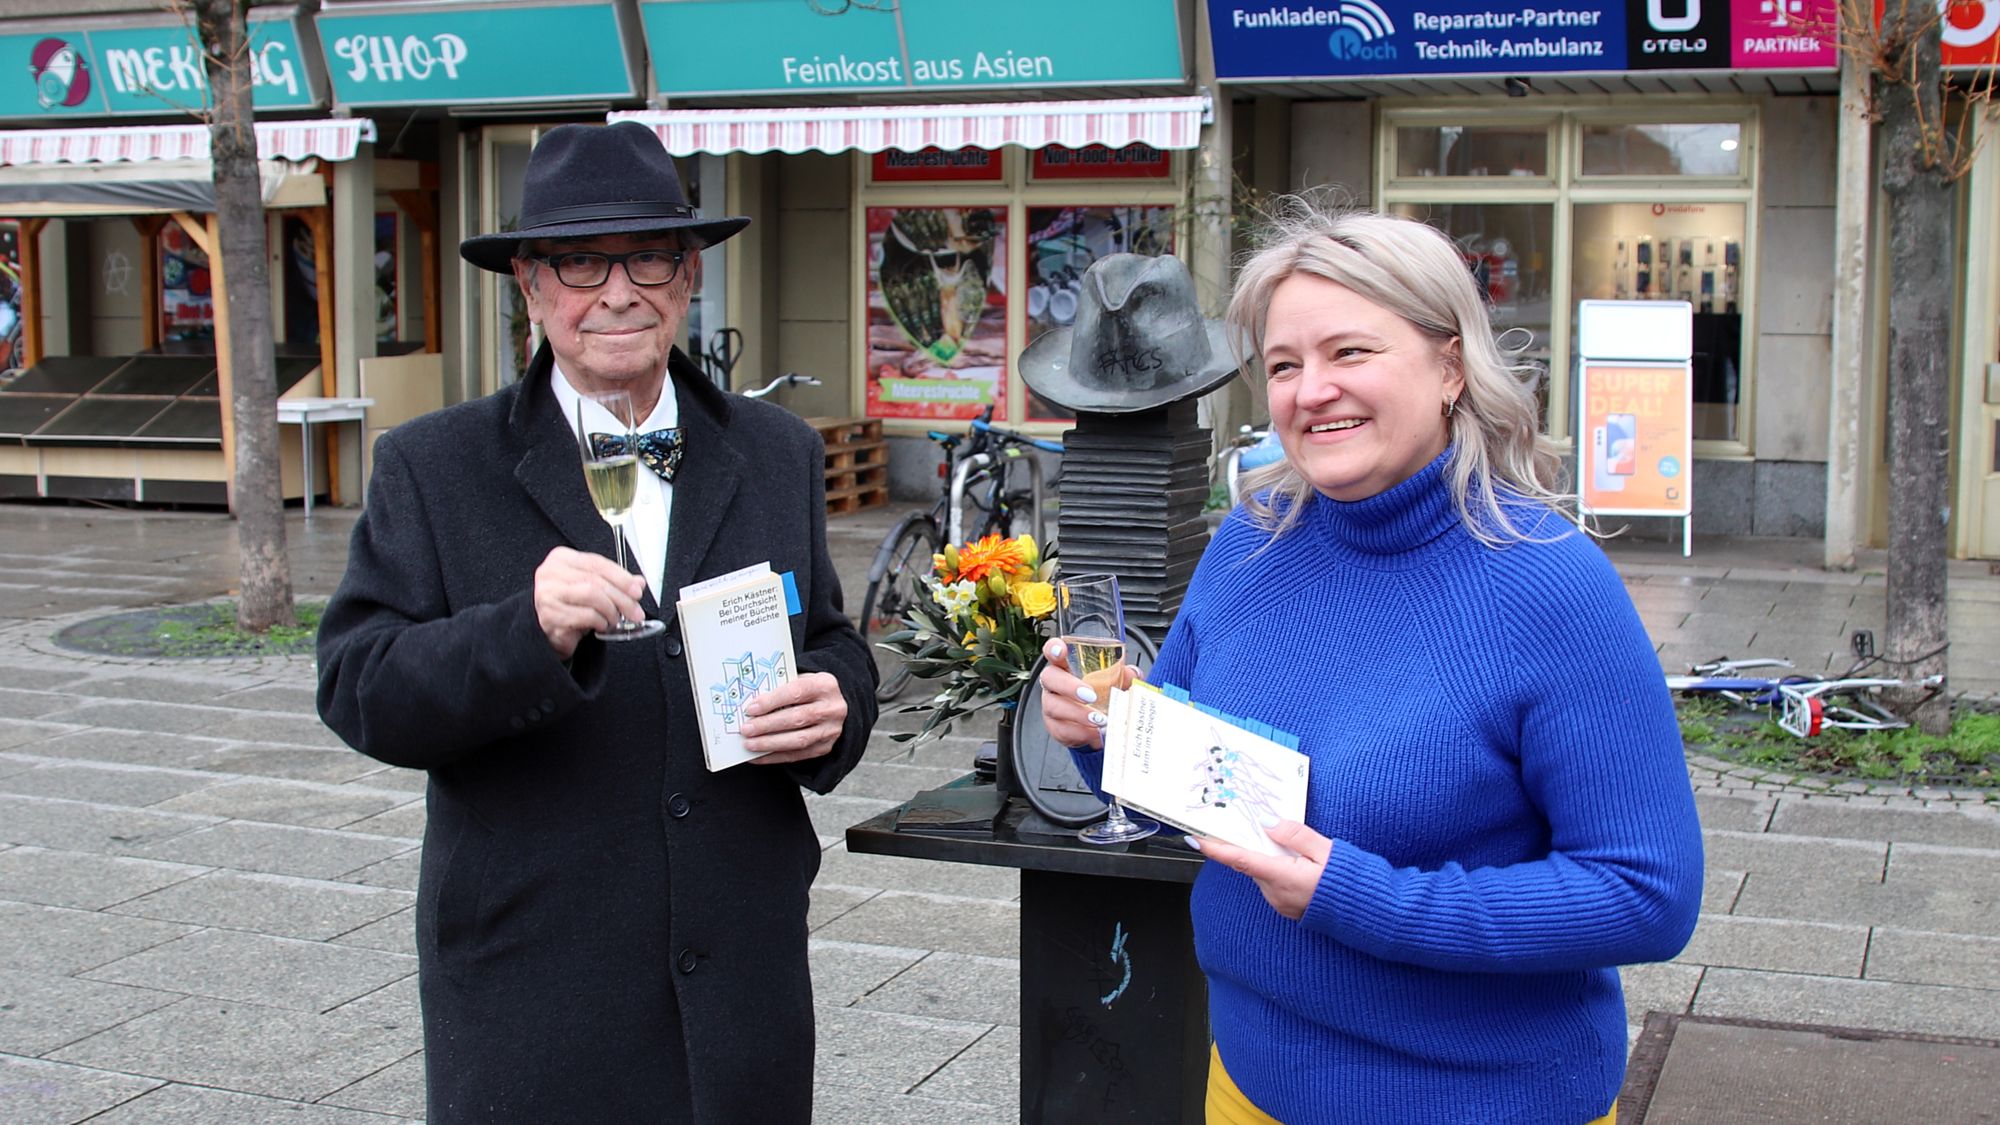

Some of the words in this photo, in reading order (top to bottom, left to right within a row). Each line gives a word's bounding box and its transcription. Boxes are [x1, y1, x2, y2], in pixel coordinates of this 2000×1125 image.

[1233, 6, 1341, 28] Funkladen
[1413, 9, 1601, 33] Reparatur-Partner
[1415, 37, 1603, 59] Technik-Ambulanz
[1743, 37, 1821, 54] PARTNER
[105, 41, 299, 96] MEKG
[334, 33, 468, 83] SHOP
[782, 54, 902, 84] Feinkost
[913, 59, 963, 80] aus
[972, 50, 1054, 78] Asien
[1590, 372, 1671, 395] SUPER
[1590, 396, 1664, 416] DEAL!
[719, 608, 733, 618] Bei
[733, 594, 777, 613] Durchsicht
[722, 596, 744, 608] Erich
[720, 613, 748, 627] meiner
[743, 612, 780, 628] Gedichte
[1133, 733, 1142, 758] Erich
